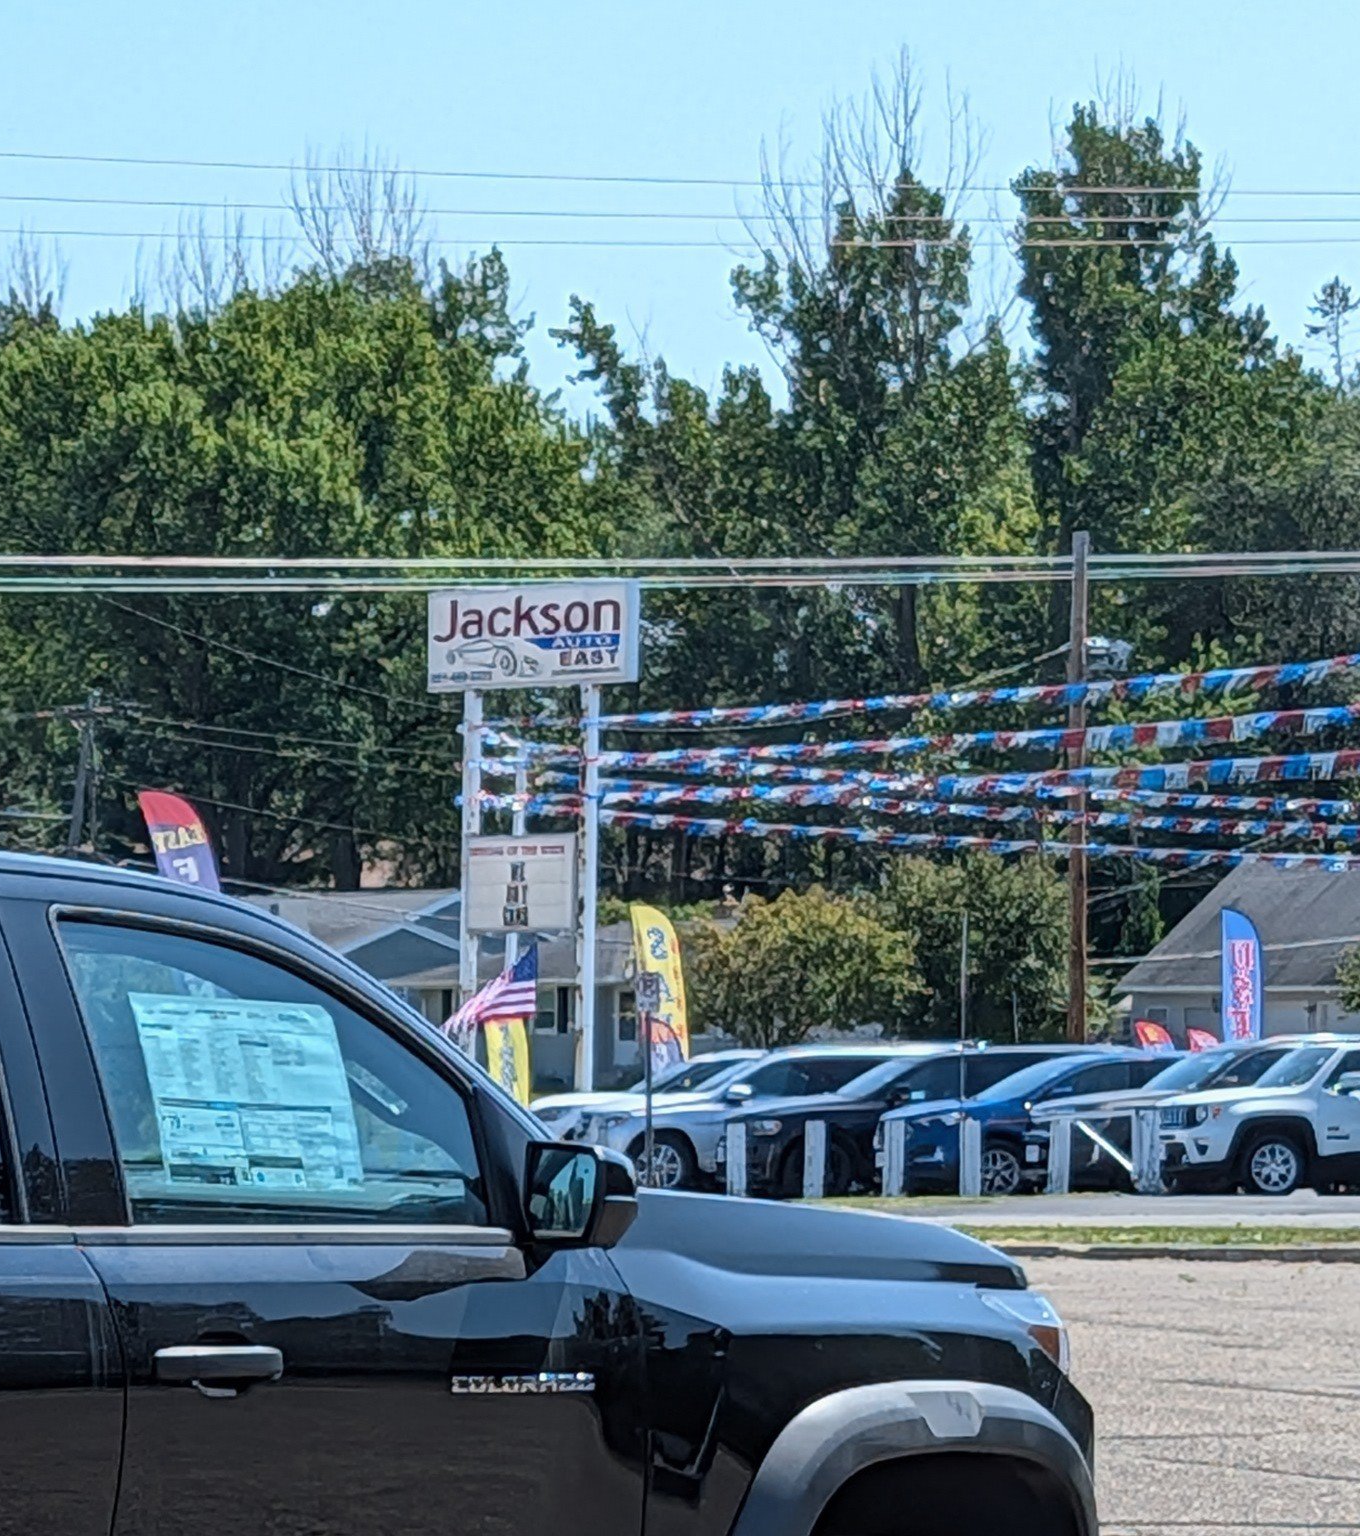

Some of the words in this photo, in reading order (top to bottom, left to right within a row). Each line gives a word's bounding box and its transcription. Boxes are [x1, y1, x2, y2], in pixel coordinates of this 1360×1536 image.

[433, 595, 621, 643] Jackson
[550, 634, 614, 650] AUTO
[559, 649, 620, 666] EAST
